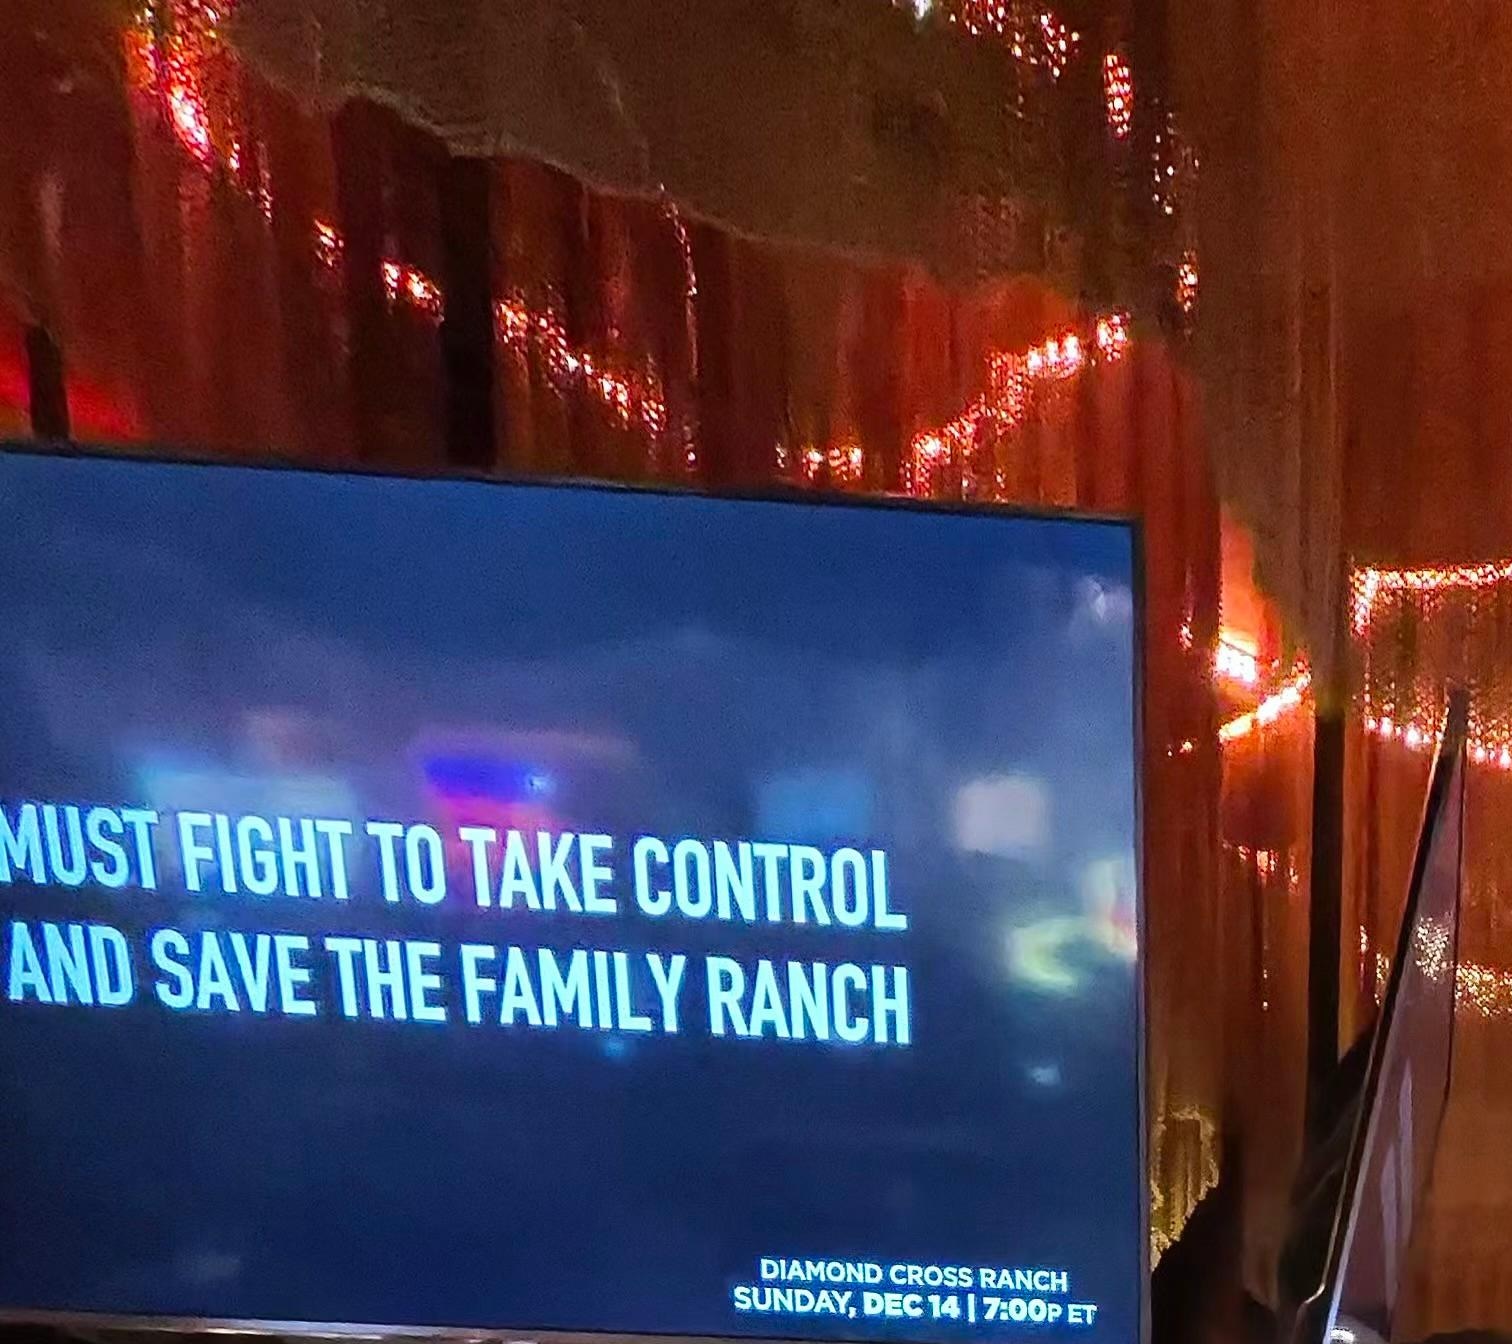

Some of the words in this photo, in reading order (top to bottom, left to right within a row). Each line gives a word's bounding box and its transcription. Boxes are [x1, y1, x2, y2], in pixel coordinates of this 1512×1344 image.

[0, 803, 158, 889] MUST
[178, 811, 353, 900] FIGHT
[365, 821, 447, 905] TO
[459, 827, 618, 915] TAKE
[633, 836, 908, 931] CONTROL
[9, 921, 133, 1005] AND
[152, 928, 317, 1016] SAVE
[324, 937, 447, 1022] THE
[460, 943, 687, 1033] FAMILY
[706, 956, 910, 1045] RANCH
[733, 1286, 857, 1319] SUNDAY,
[863, 1291, 925, 1318] DEC
[928, 1294, 960, 1320] 14
[1067, 1303, 1098, 1325] ET
[760, 1258, 883, 1284] DIAMOND
[889, 1264, 974, 1288] CROSS
[980, 1267, 1068, 1294] RANCH
